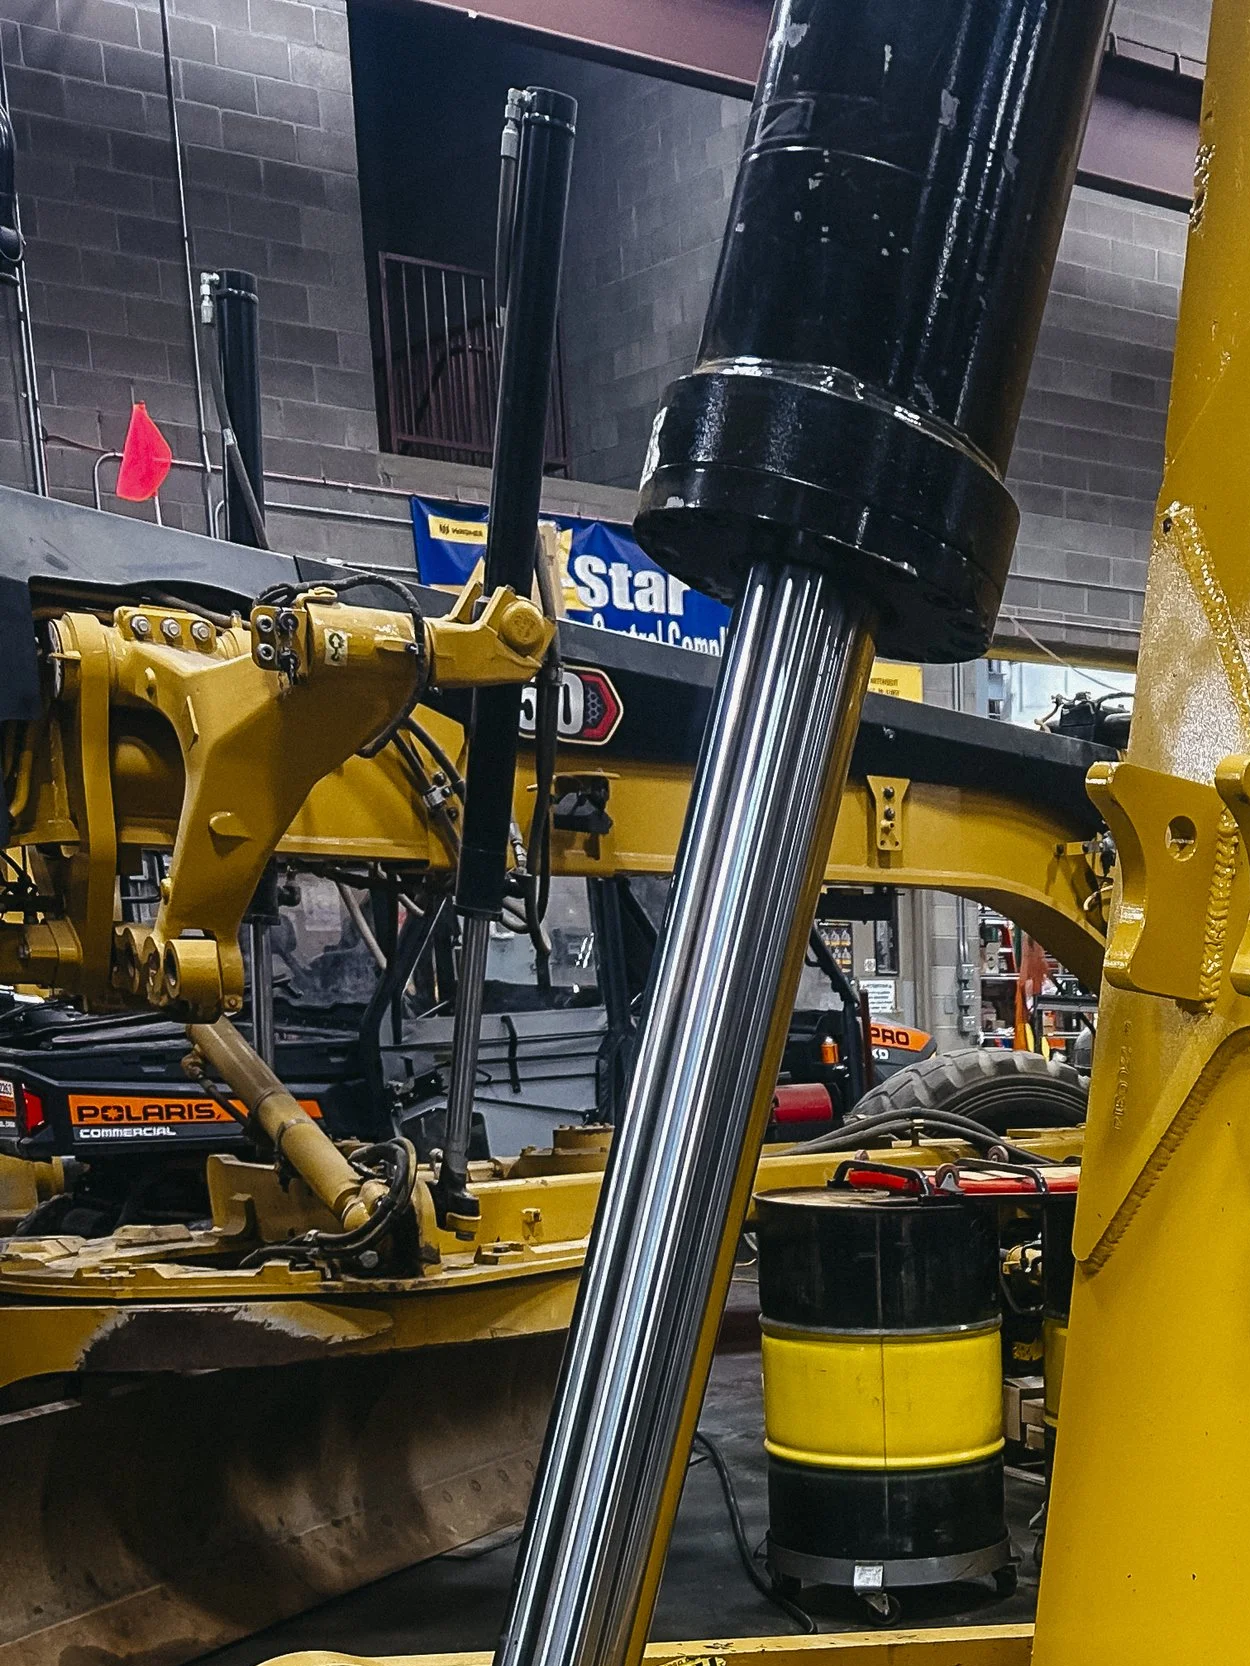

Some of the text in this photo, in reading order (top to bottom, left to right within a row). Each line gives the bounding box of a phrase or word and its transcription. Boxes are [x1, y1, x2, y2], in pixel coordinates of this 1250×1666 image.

[573, 554, 691, 616] Star
[77, 1103, 215, 1122] POLARIS
[79, 1126, 177, 1139] COMMERCIAL
